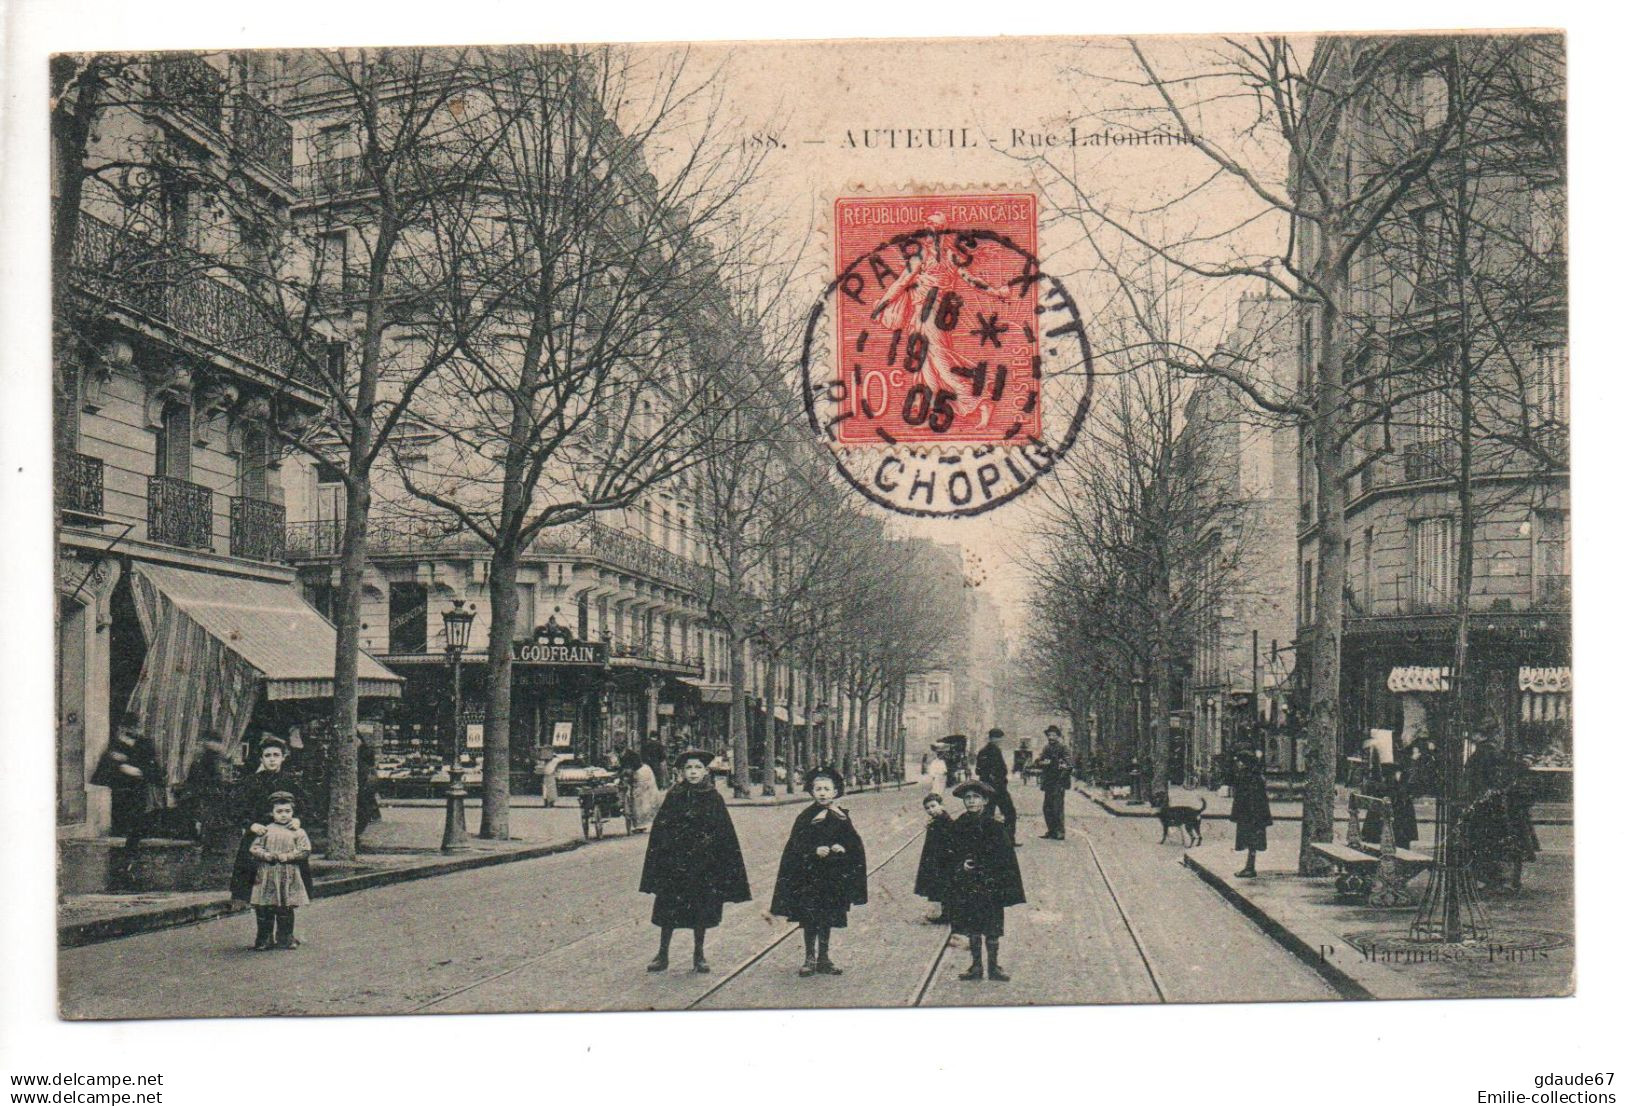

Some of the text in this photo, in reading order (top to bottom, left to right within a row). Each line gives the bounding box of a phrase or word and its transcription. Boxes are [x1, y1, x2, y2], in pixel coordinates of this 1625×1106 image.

[841, 128, 978, 149] AUTEUIL
[1011, 128, 1058, 148] Rue
[840, 230, 977, 305] PARIS
[1011, 346, 1031, 424] POSTES
[902, 383, 957, 433] 05
[521, 645, 594, 662] GODFRAIN
[1488, 943, 1549, 962] Paris
